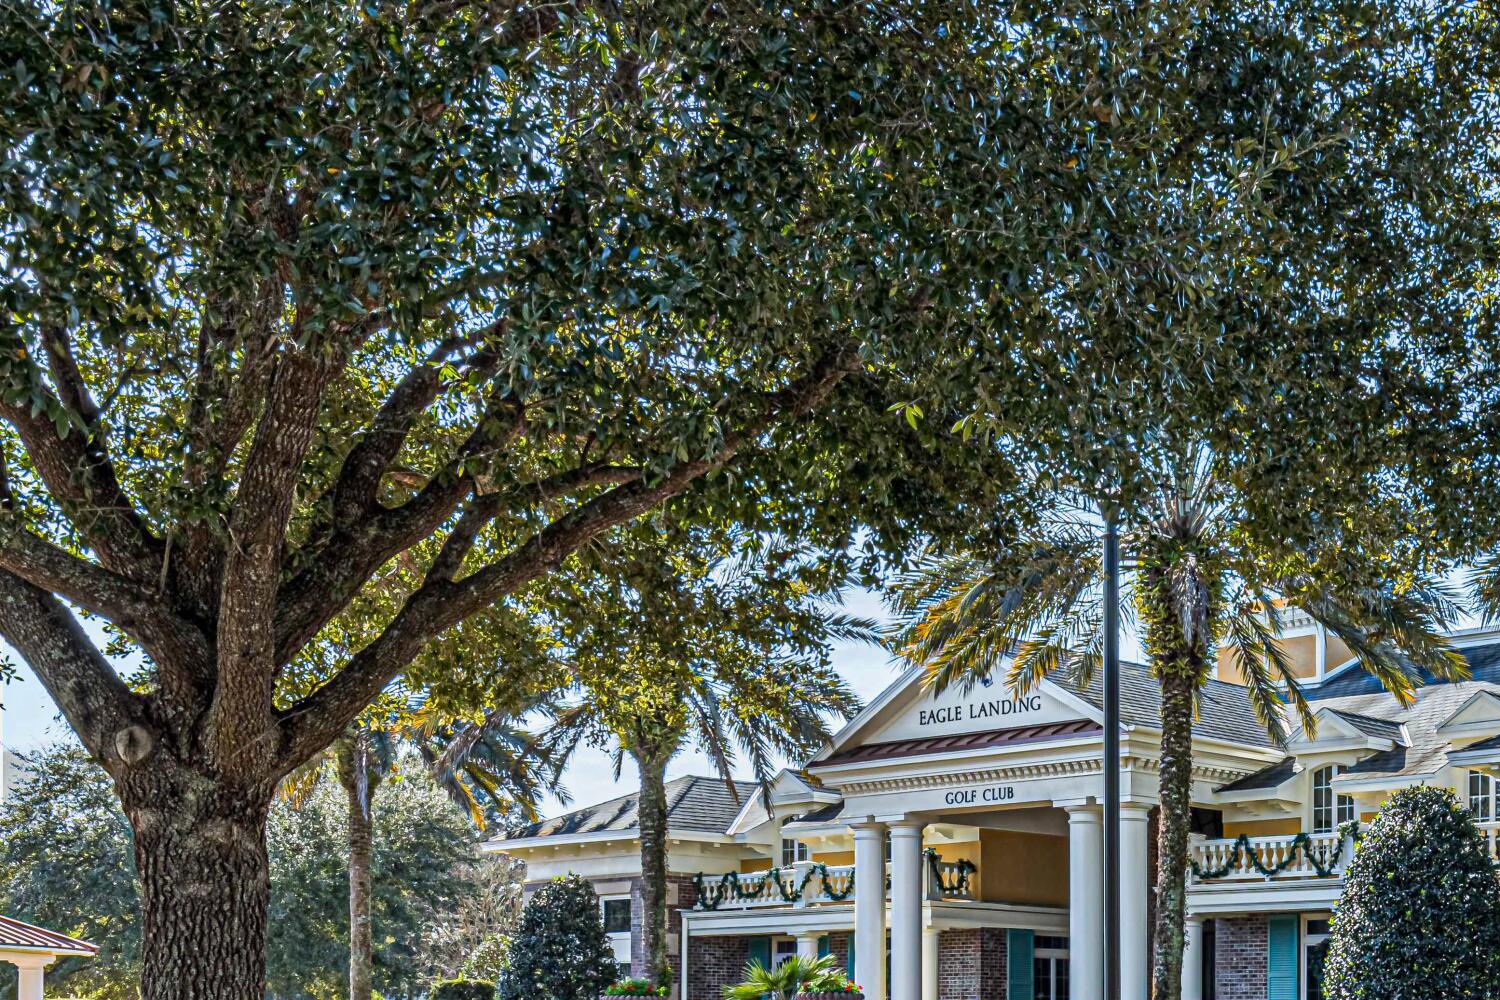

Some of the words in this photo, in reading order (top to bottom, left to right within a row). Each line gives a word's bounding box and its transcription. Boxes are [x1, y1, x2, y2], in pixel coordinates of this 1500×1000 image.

[920, 706, 962, 726] EAGLE
[969, 696, 1041, 719] LANDING
[945, 790, 977, 805] GOLF
[983, 787, 1014, 801] CLUB
